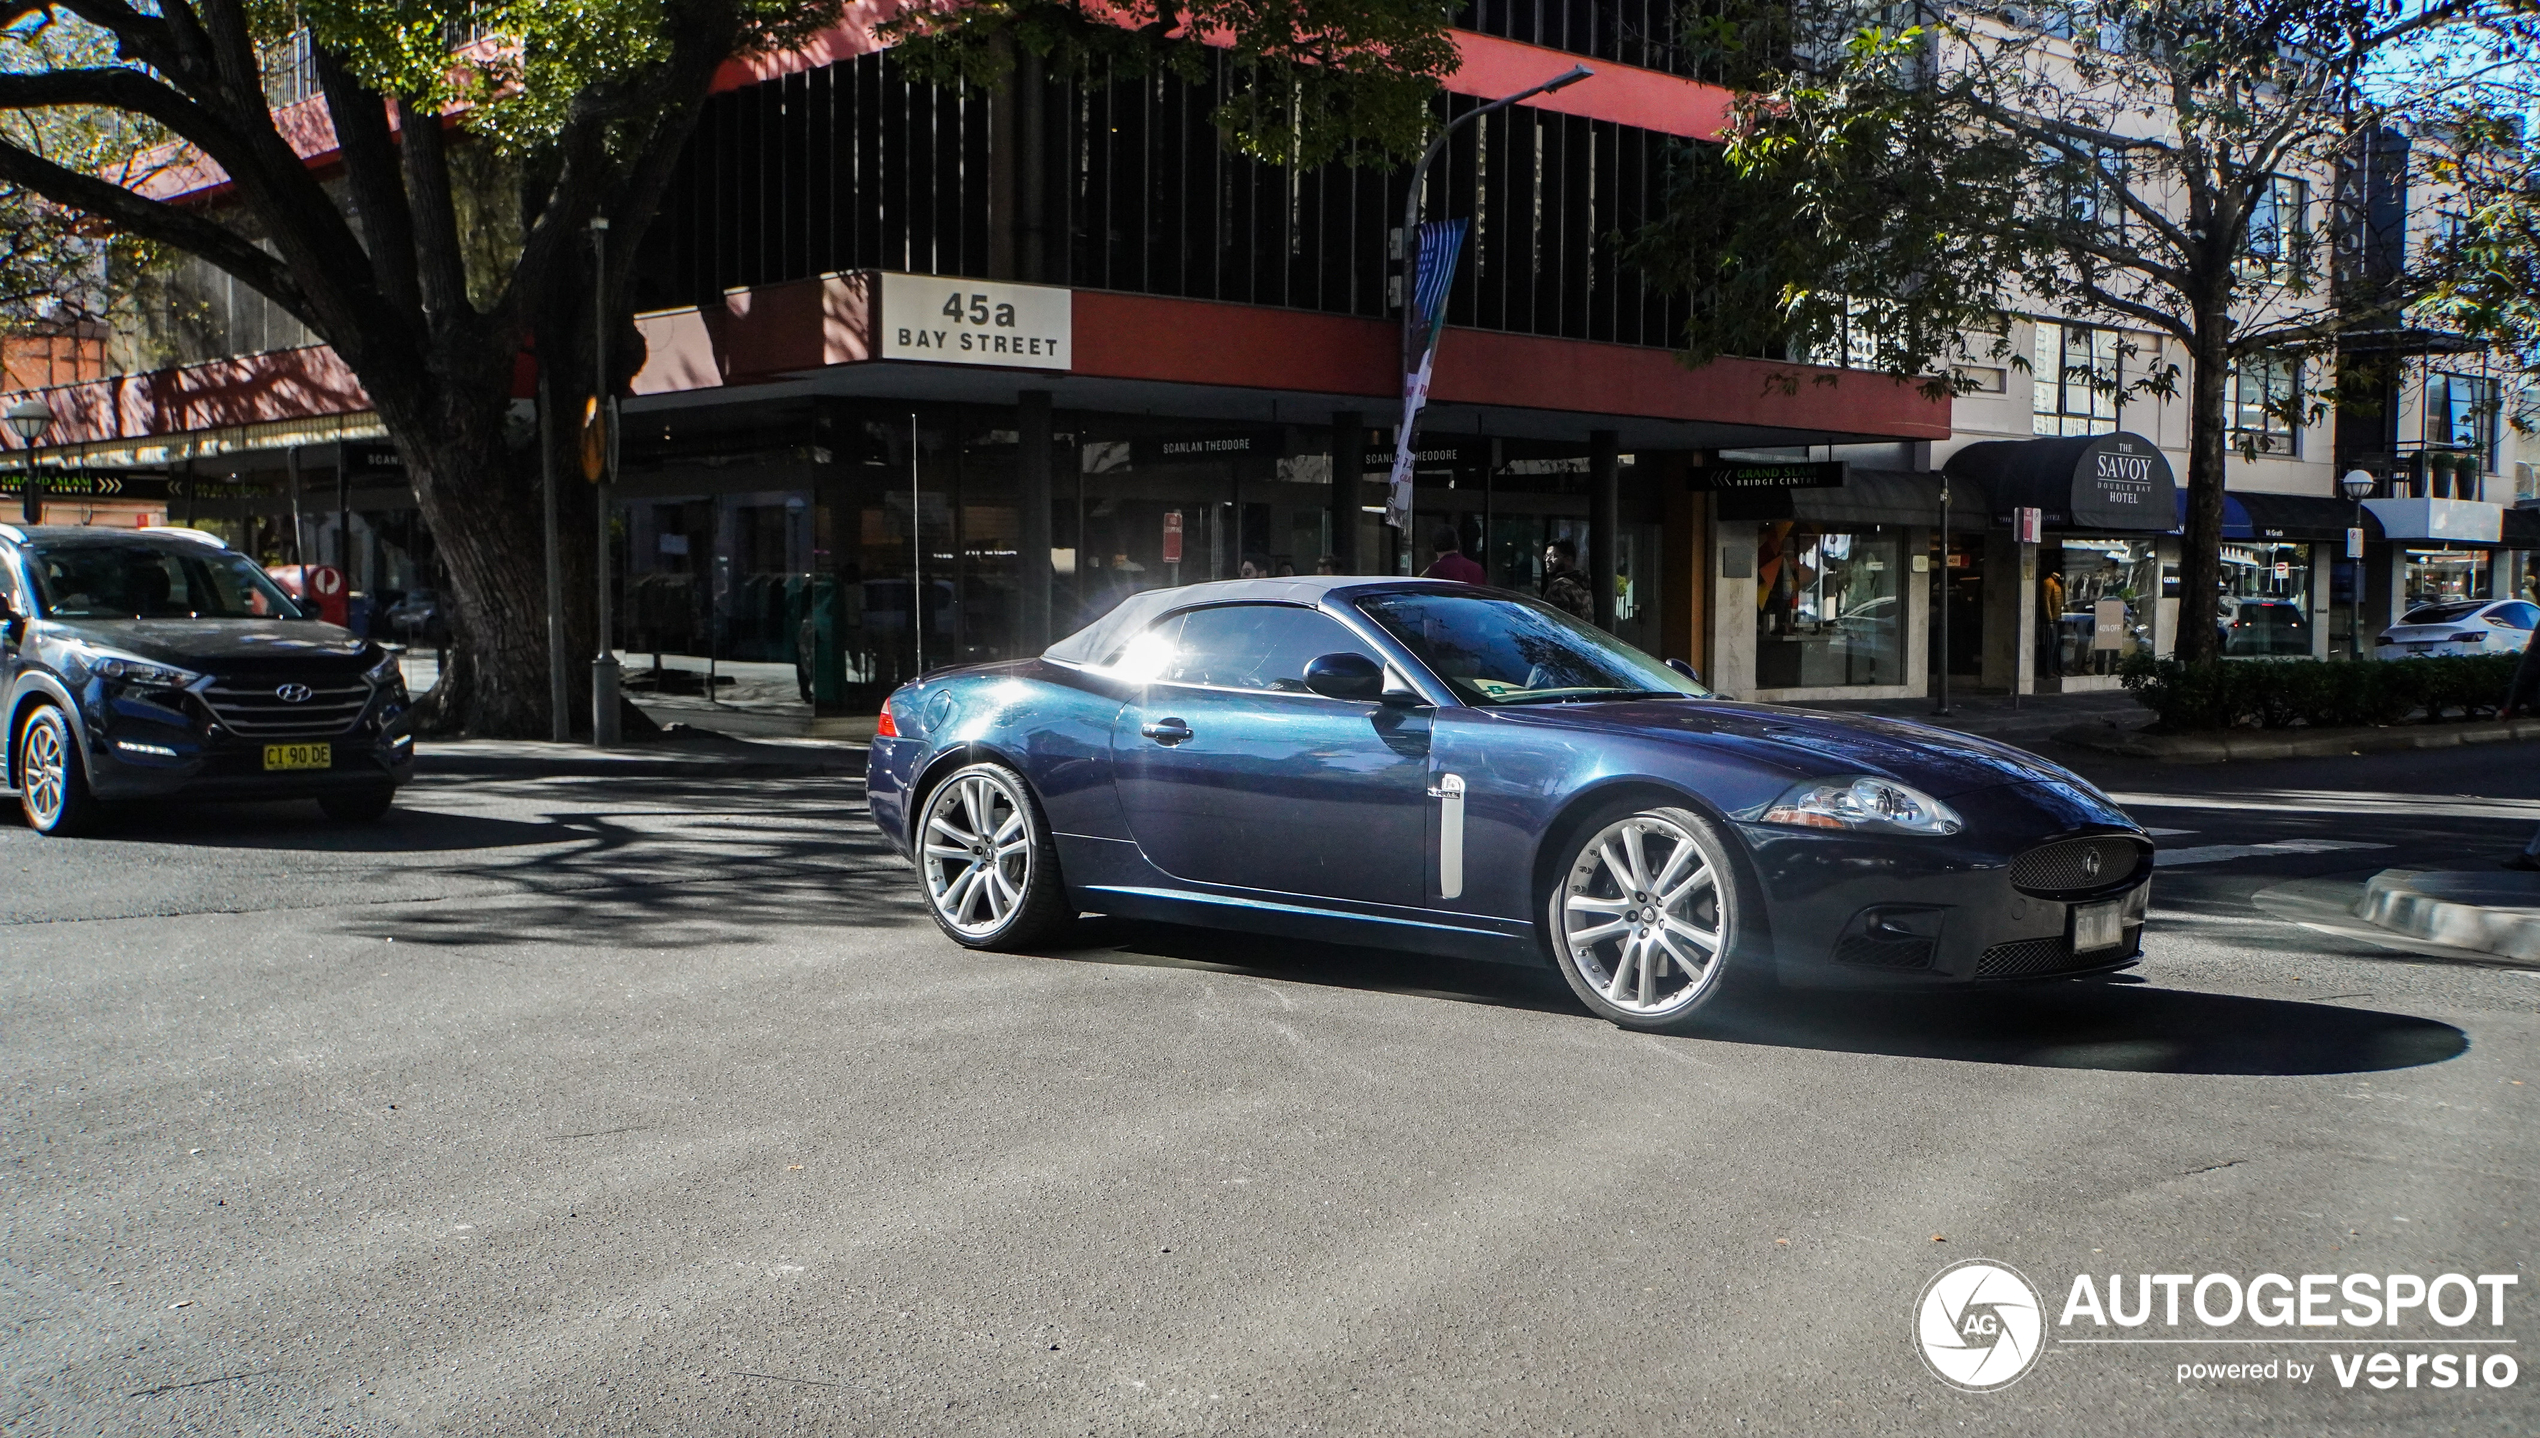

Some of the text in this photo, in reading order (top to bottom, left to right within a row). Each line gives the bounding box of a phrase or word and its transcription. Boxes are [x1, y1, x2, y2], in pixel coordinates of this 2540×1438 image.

[943, 293, 1015, 328] 45a
[898, 328, 1058, 357] BAY STREET
[1163, 438, 1250, 454] SCANLAN THEODORE
[2118, 443, 2133, 453] THE
[367, 453, 399, 466] SCAN
[1365, 453, 1395, 465] SCANL
[1416, 449, 1458, 462] HEODORE
[1737, 466, 1818, 479] GRAND SLAM
[2097, 455, 2152, 481] SAVOY
[56, 476, 92, 487] SLAM
[1736, 477, 1818, 487] BRIDGE CENTRE
[2097, 481, 2152, 493] DOUBLE BAY
[2109, 491, 2139, 504] HOTEL
[290, 747, 307, 764] 90
[312, 746, 329, 763] DE
